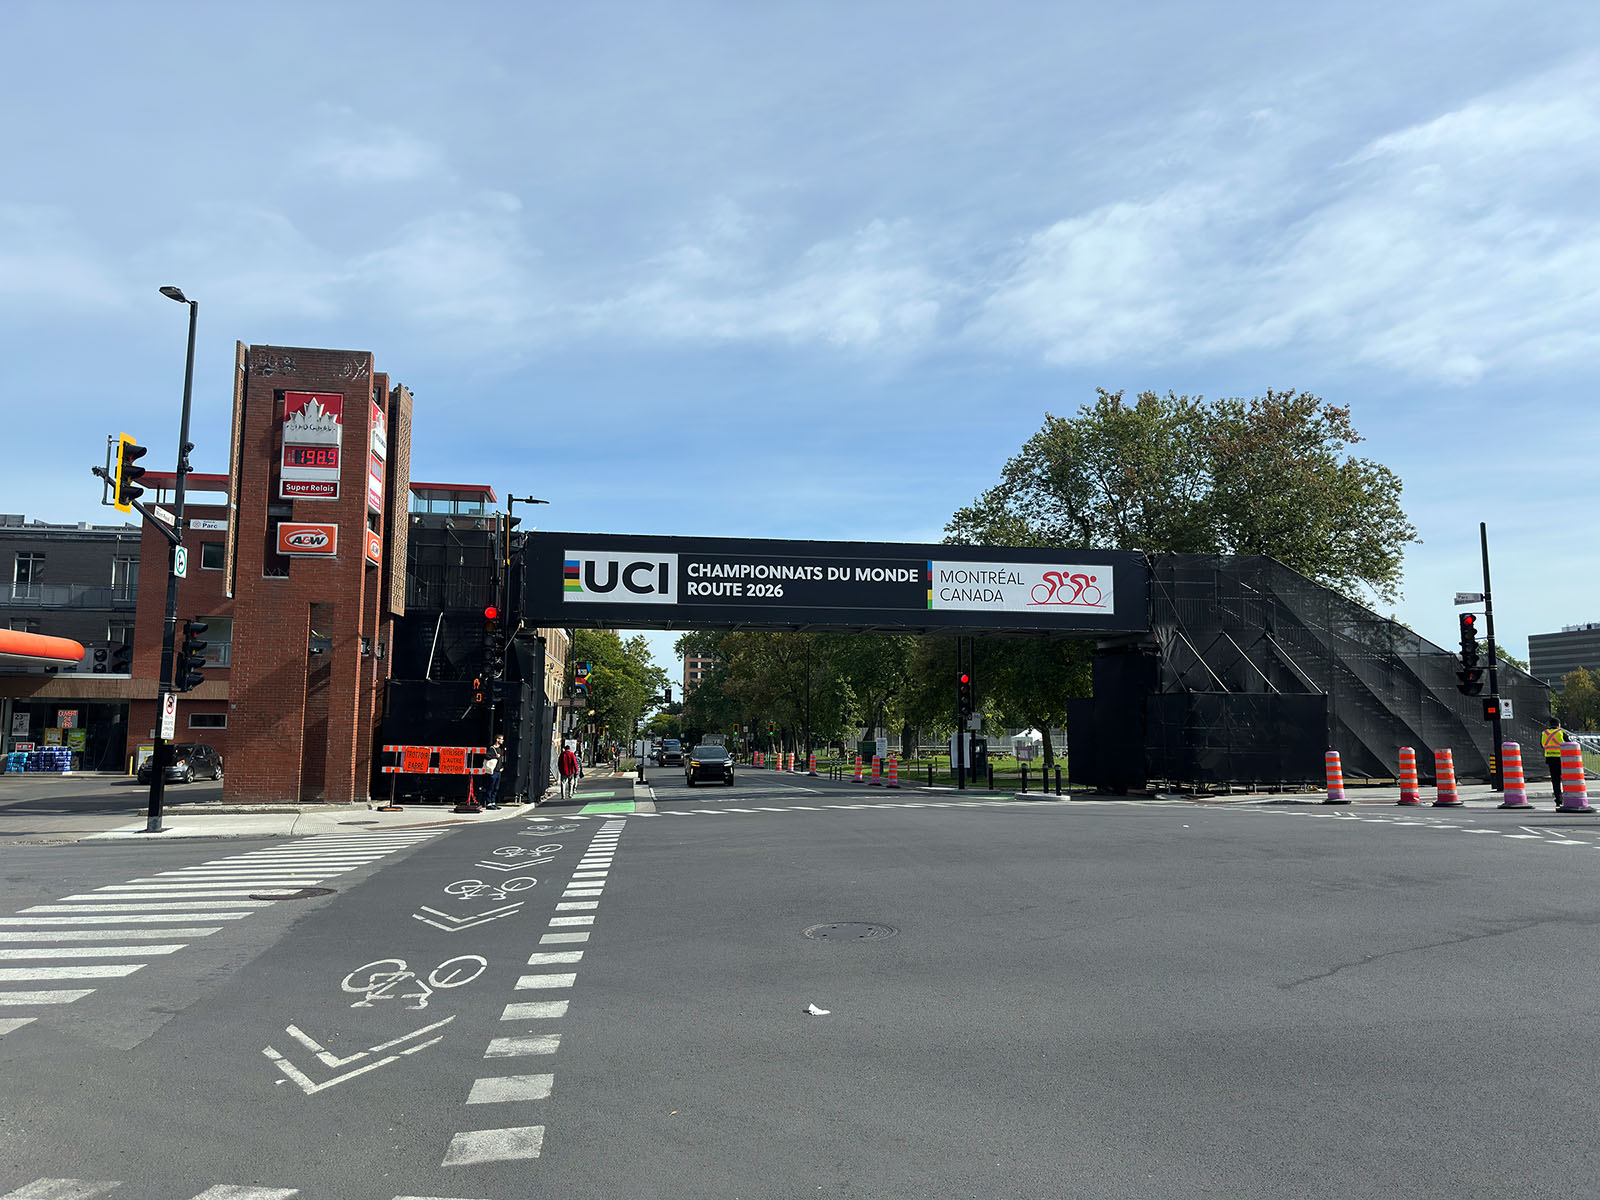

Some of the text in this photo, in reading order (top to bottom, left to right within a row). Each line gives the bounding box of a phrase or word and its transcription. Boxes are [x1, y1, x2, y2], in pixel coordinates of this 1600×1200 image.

[286, 483, 334, 492] Super Relais
[291, 536, 326, 545] A&W
[585, 560, 669, 594] UCI
[687, 563, 919, 583] CHAMPIONNATS DU MONDE
[939, 569, 1025, 586] MONTRÉAL
[687, 582, 784, 598] ROUTE 2026
[939, 587, 1004, 603] CANADA
[407, 750, 429, 760] TROTTOIR
